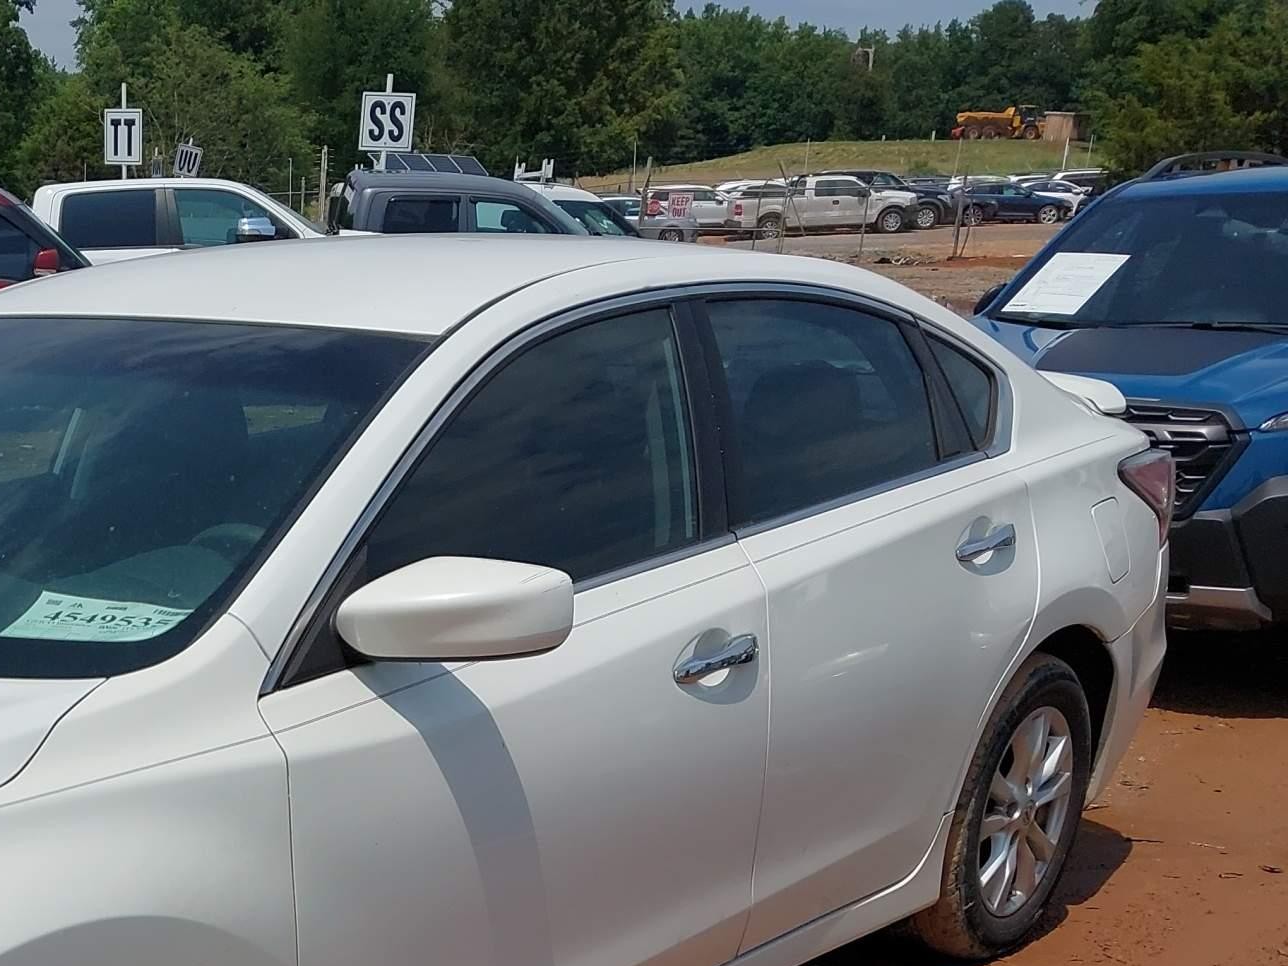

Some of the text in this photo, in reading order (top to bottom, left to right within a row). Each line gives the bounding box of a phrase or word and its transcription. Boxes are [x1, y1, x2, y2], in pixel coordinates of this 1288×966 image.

[368, 100, 406, 142] SS
[110, 118, 136, 156] TT
[178, 149, 199, 174] UU
[672, 196, 690, 206] KEEP
[672, 207, 687, 218] OUT
